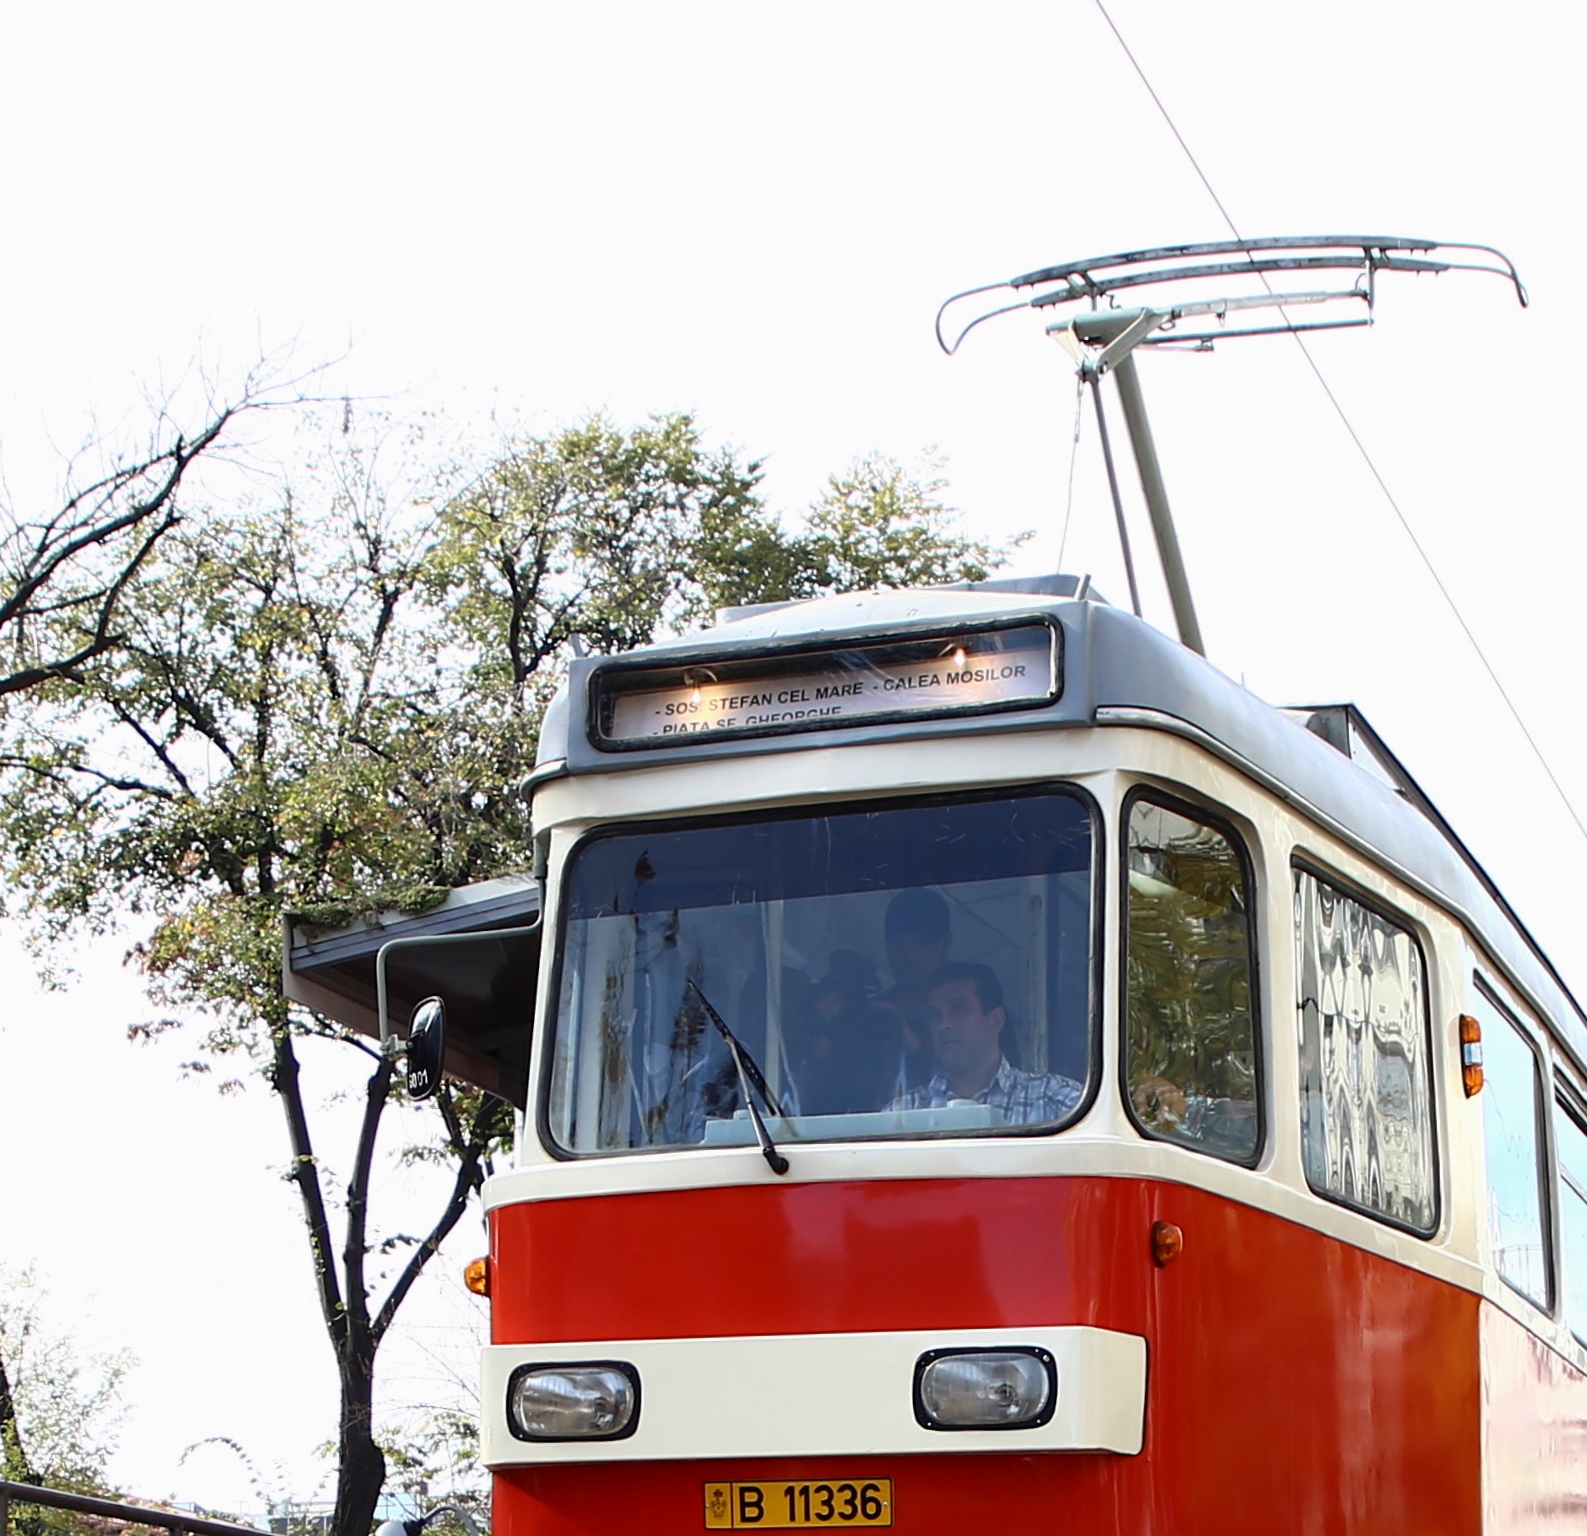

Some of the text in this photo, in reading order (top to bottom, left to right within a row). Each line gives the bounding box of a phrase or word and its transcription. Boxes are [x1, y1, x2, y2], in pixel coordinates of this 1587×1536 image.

[709, 692, 773, 712] STEFAN
[777, 689, 811, 704] CEL
[815, 682, 864, 700] MARE
[883, 673, 941, 692] CALEA
[946, 665, 1026, 685] MOSILOR
[739, 1482, 882, 1524] B 11336
